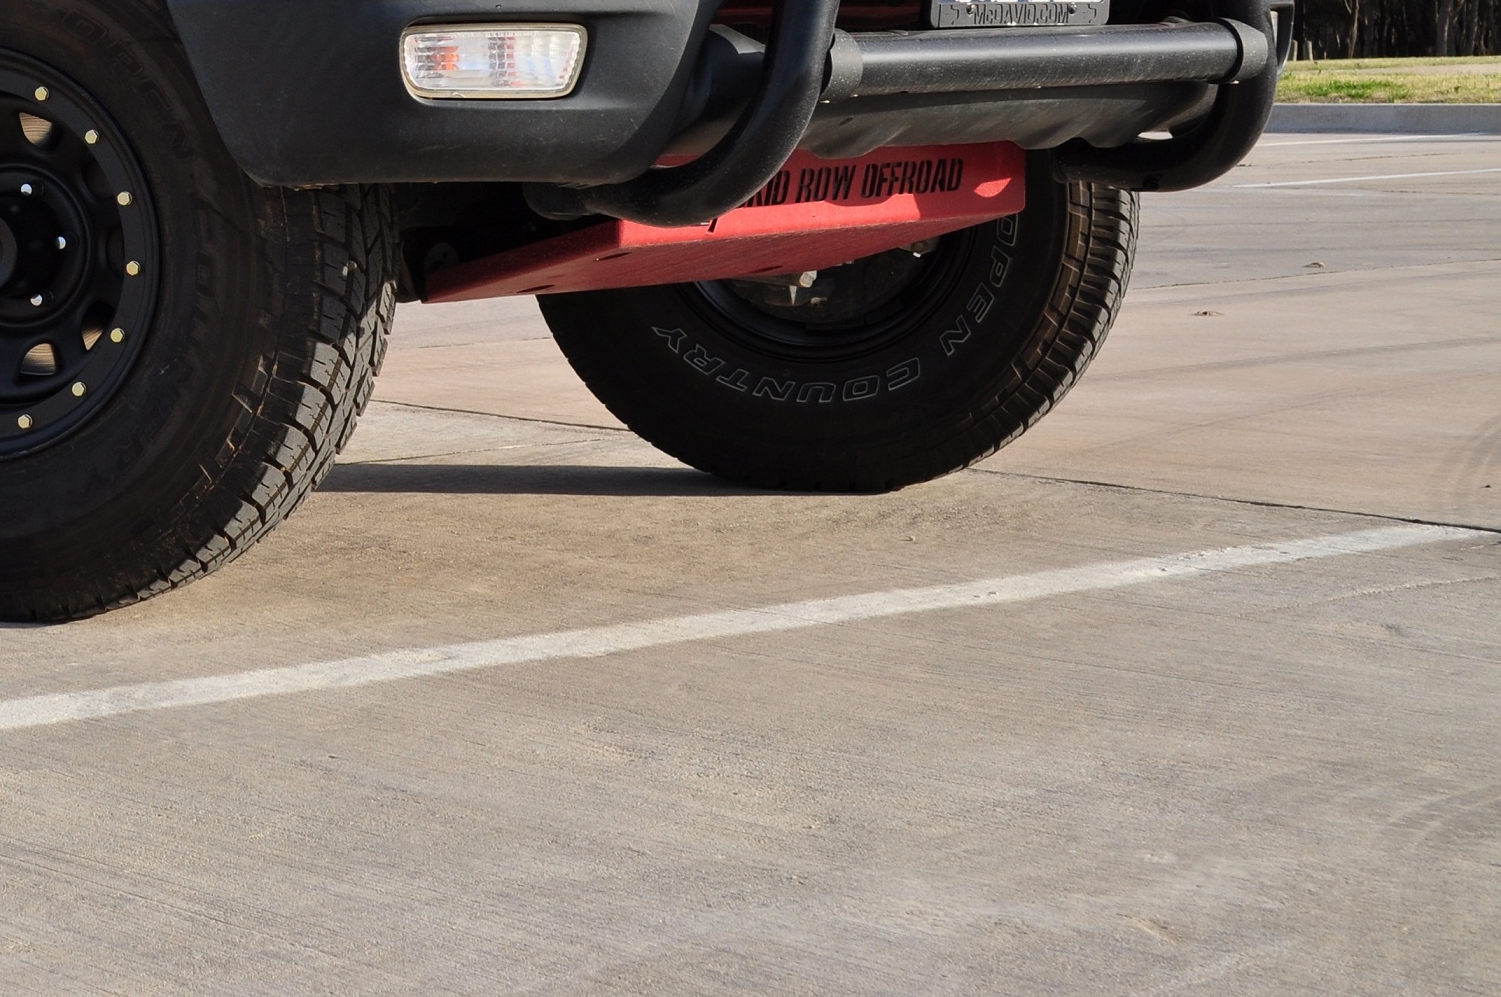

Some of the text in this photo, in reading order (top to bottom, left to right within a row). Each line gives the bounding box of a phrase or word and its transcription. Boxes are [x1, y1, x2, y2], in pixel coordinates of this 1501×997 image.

[973, 3, 1070, 25] McDAVID.COM
[737, 158, 963, 208] ID ROW OFFROAD
[650, 214, 1016, 405] OPEN COUNTRY
